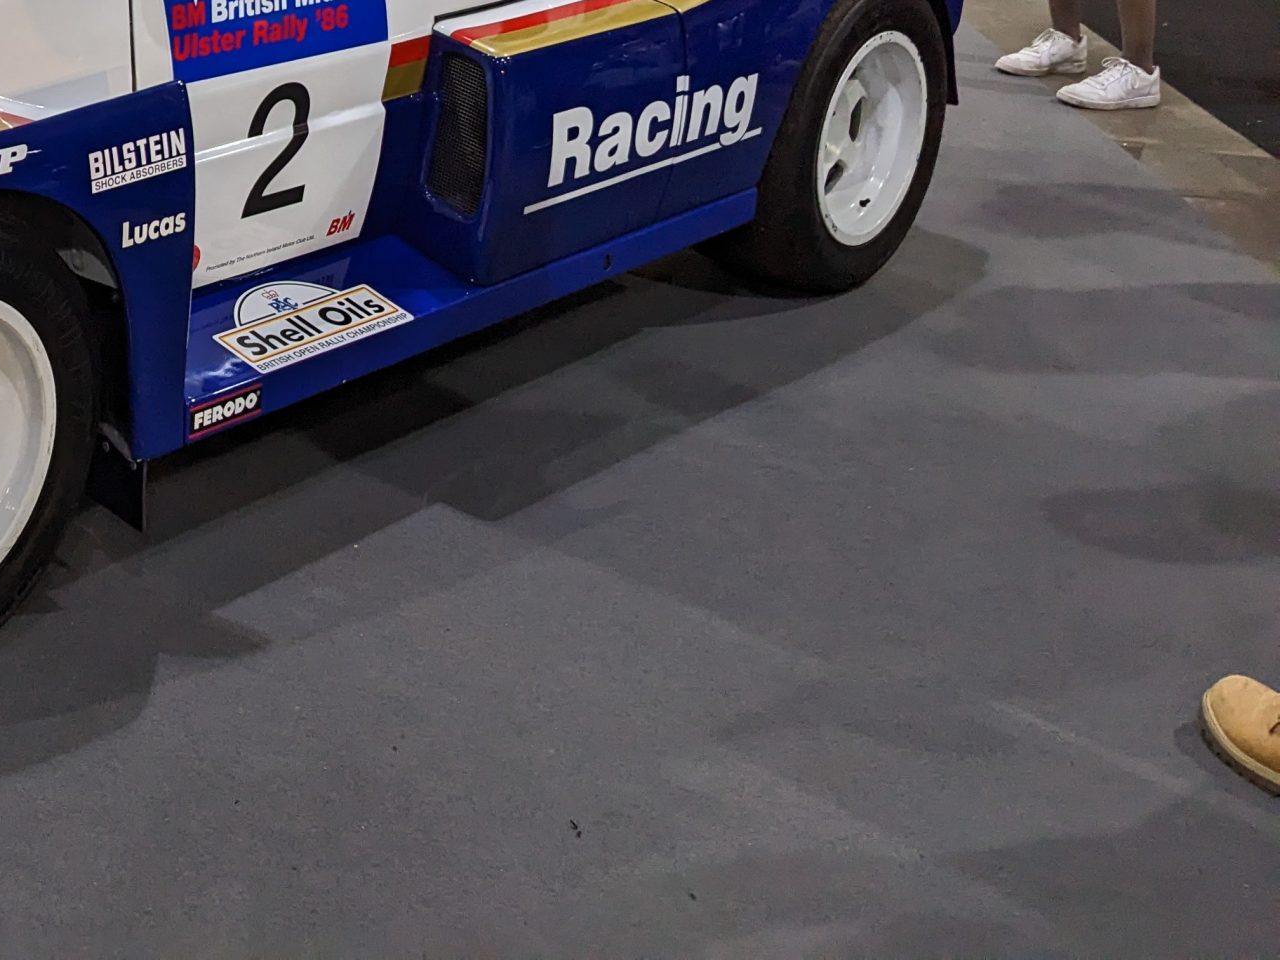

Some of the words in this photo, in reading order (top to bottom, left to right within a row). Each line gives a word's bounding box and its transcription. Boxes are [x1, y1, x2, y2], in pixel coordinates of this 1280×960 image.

[173, 29, 246, 61] Ulster
[253, 16, 308, 46] Rally
[88, 128, 186, 180] BILSTEIN
[241, 82, 310, 219] 2
[547, 73, 759, 187] Racing
[95, 173, 127, 191] SHOCK
[129, 157, 184, 181] ABSORBERS
[122, 212, 186, 249] Lucas
[326, 210, 356, 236] BM
[236, 314, 323, 356] Shell
[319, 298, 385, 327] Oils
[256, 354, 295, 372] BRITISH
[294, 344, 320, 359] OPEN
[320, 333, 347, 349] RALLY
[346, 312, 408, 339] CHAMPIONSHIP
[194, 392, 258, 431] FERODO
